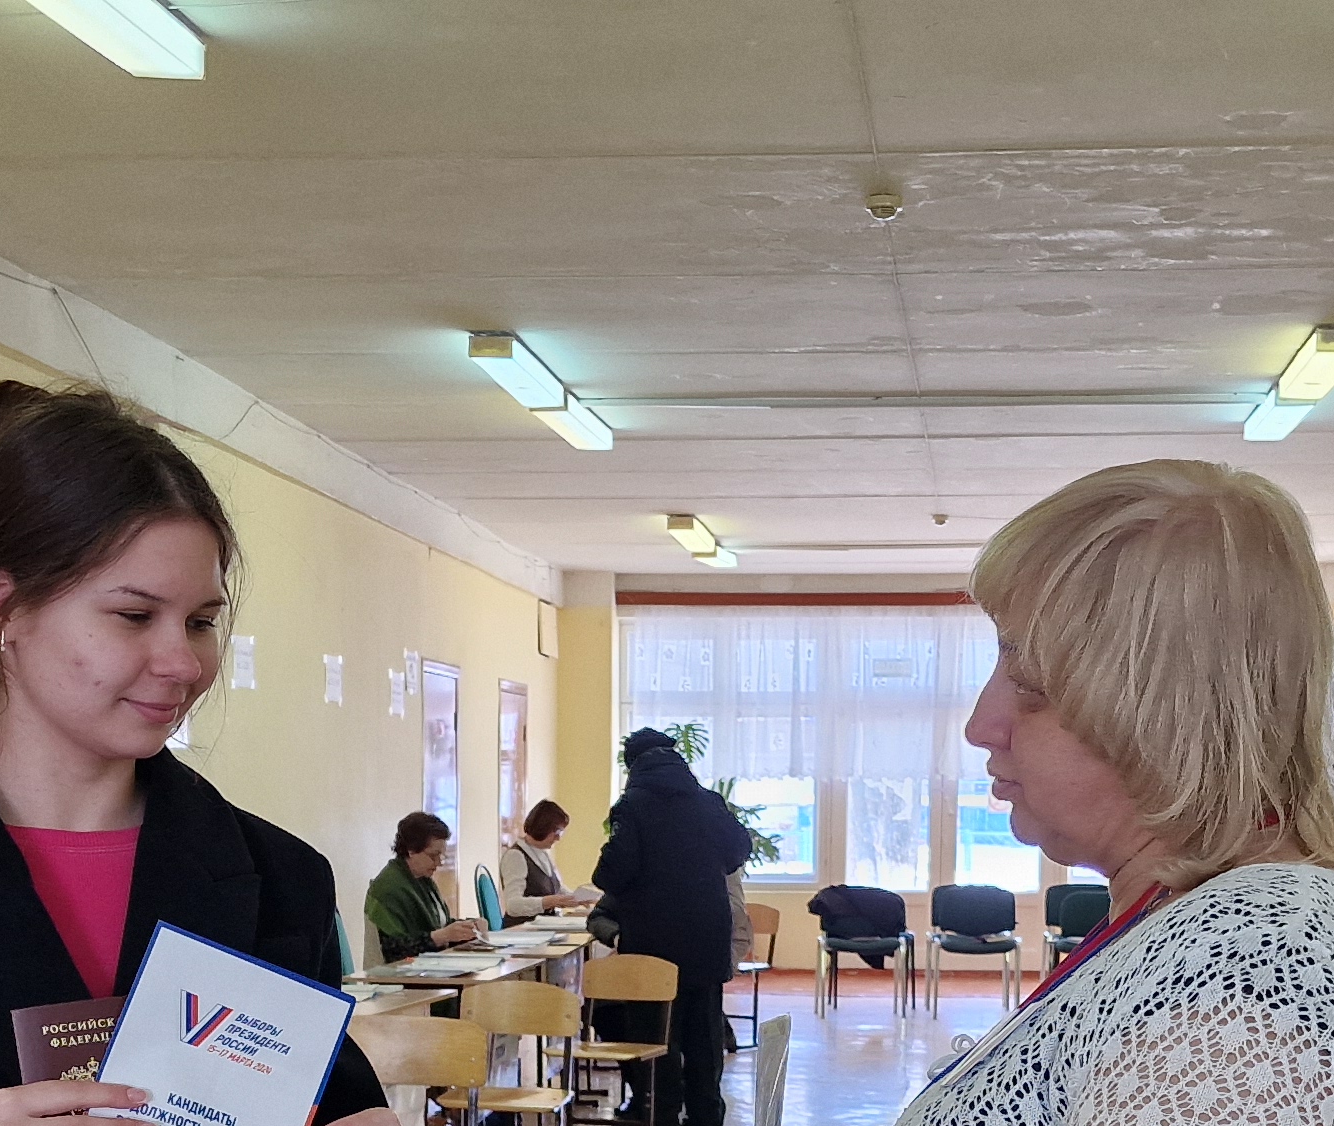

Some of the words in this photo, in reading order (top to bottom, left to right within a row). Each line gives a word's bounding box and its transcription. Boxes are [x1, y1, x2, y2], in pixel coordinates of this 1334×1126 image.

[42, 1018, 116, 1036] РОССИЙСК
[235, 1013, 283, 1037] ВЫБОРЫ
[50, 1032, 113, 1048] ФЕДЕРАЦ
[214, 1034, 259, 1056] РОССИИ
[224, 1024, 291, 1056] ПРЕЗИДЕНТА
[227, 1053, 254, 1068] МАРТА
[253, 1062, 273, 1075] 2024
